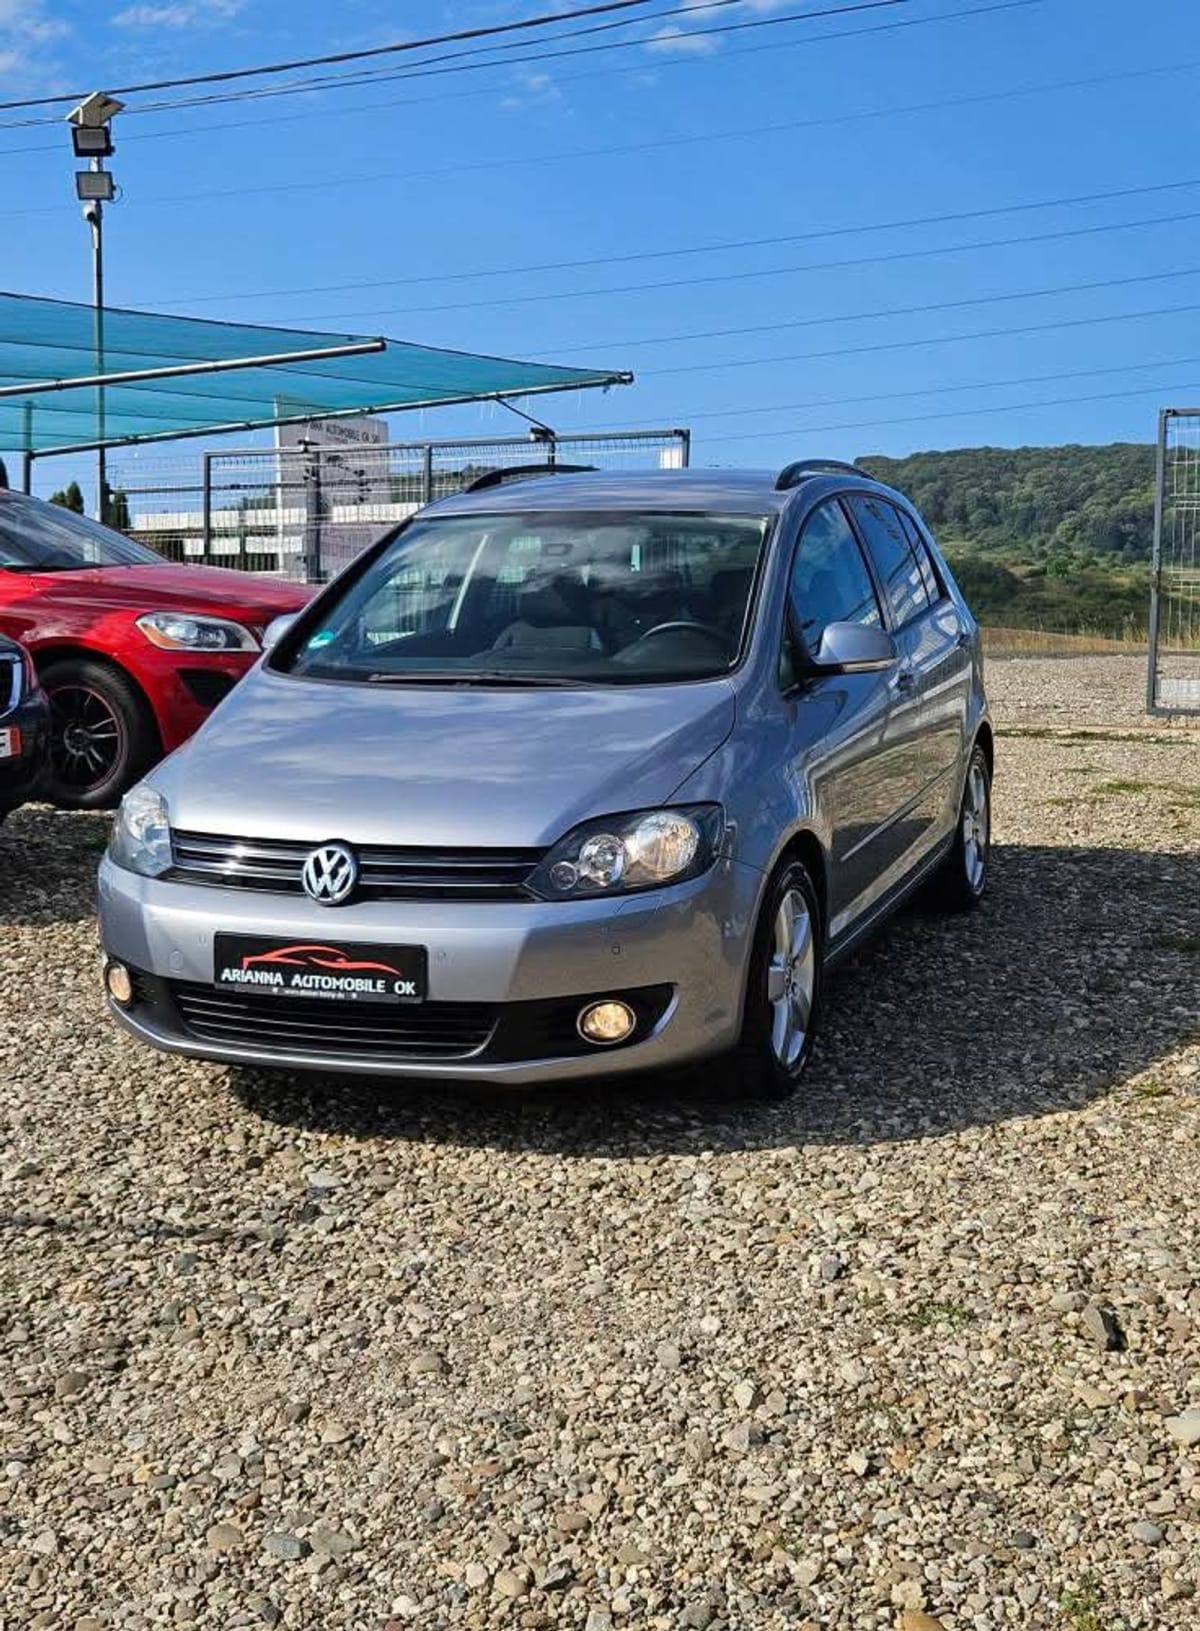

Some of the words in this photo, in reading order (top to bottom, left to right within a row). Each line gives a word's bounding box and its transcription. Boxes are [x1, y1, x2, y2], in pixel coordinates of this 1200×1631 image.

[302, 846, 354, 903] VW
[221, 968, 284, 986] ARIANNA
[291, 974, 386, 993] AUTOMOBILE
[394, 981, 416, 995] OK
